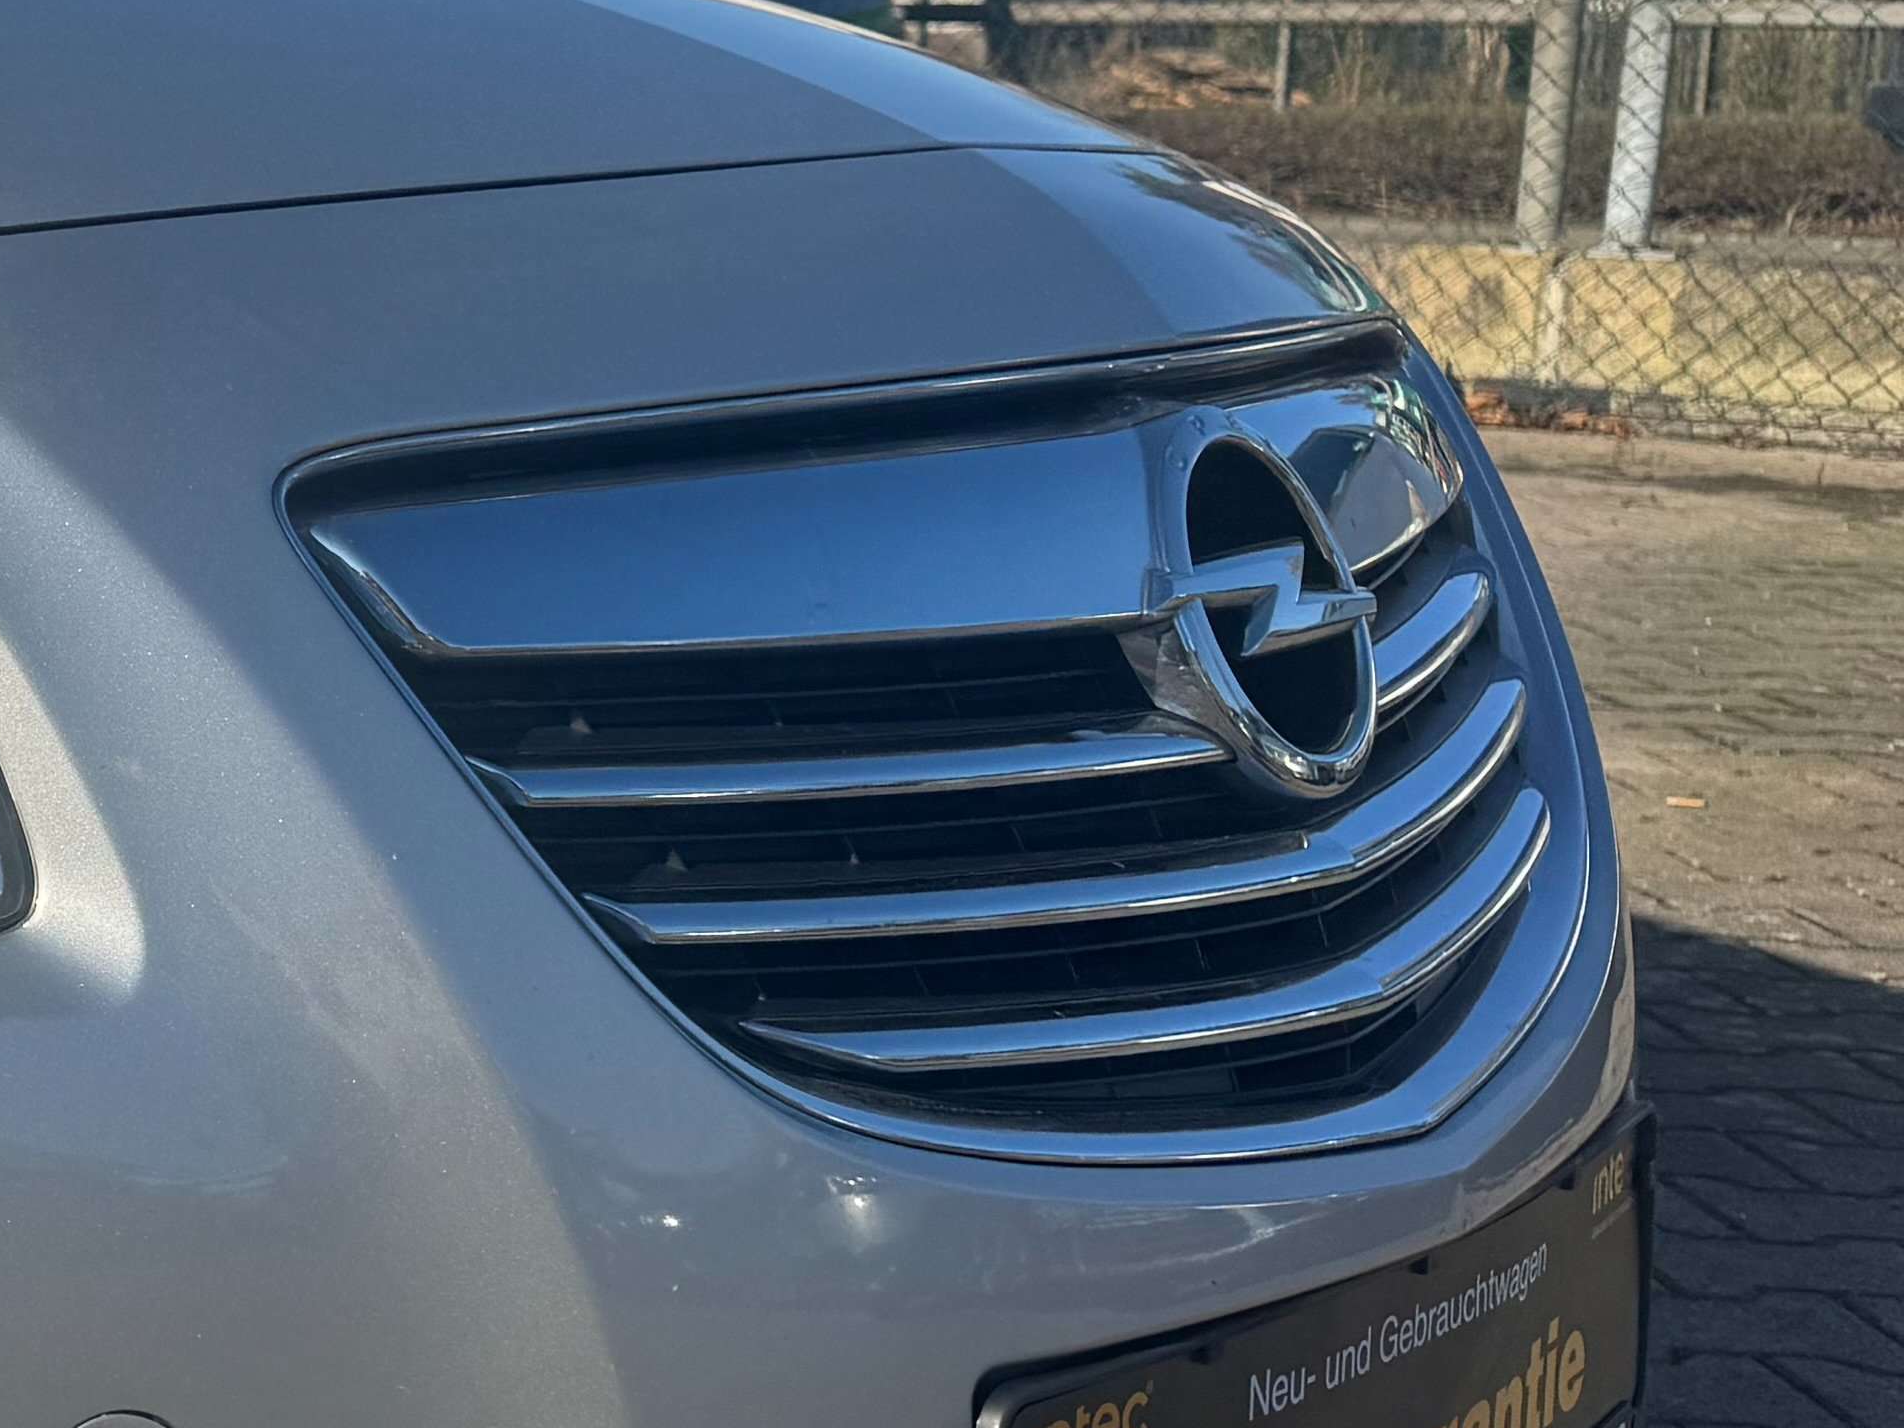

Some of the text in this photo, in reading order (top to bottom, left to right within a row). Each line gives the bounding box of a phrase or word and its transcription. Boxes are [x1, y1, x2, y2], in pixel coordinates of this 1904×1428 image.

[1249, 1241, 1548, 1422] Neu- und Gebrauchtwagen
